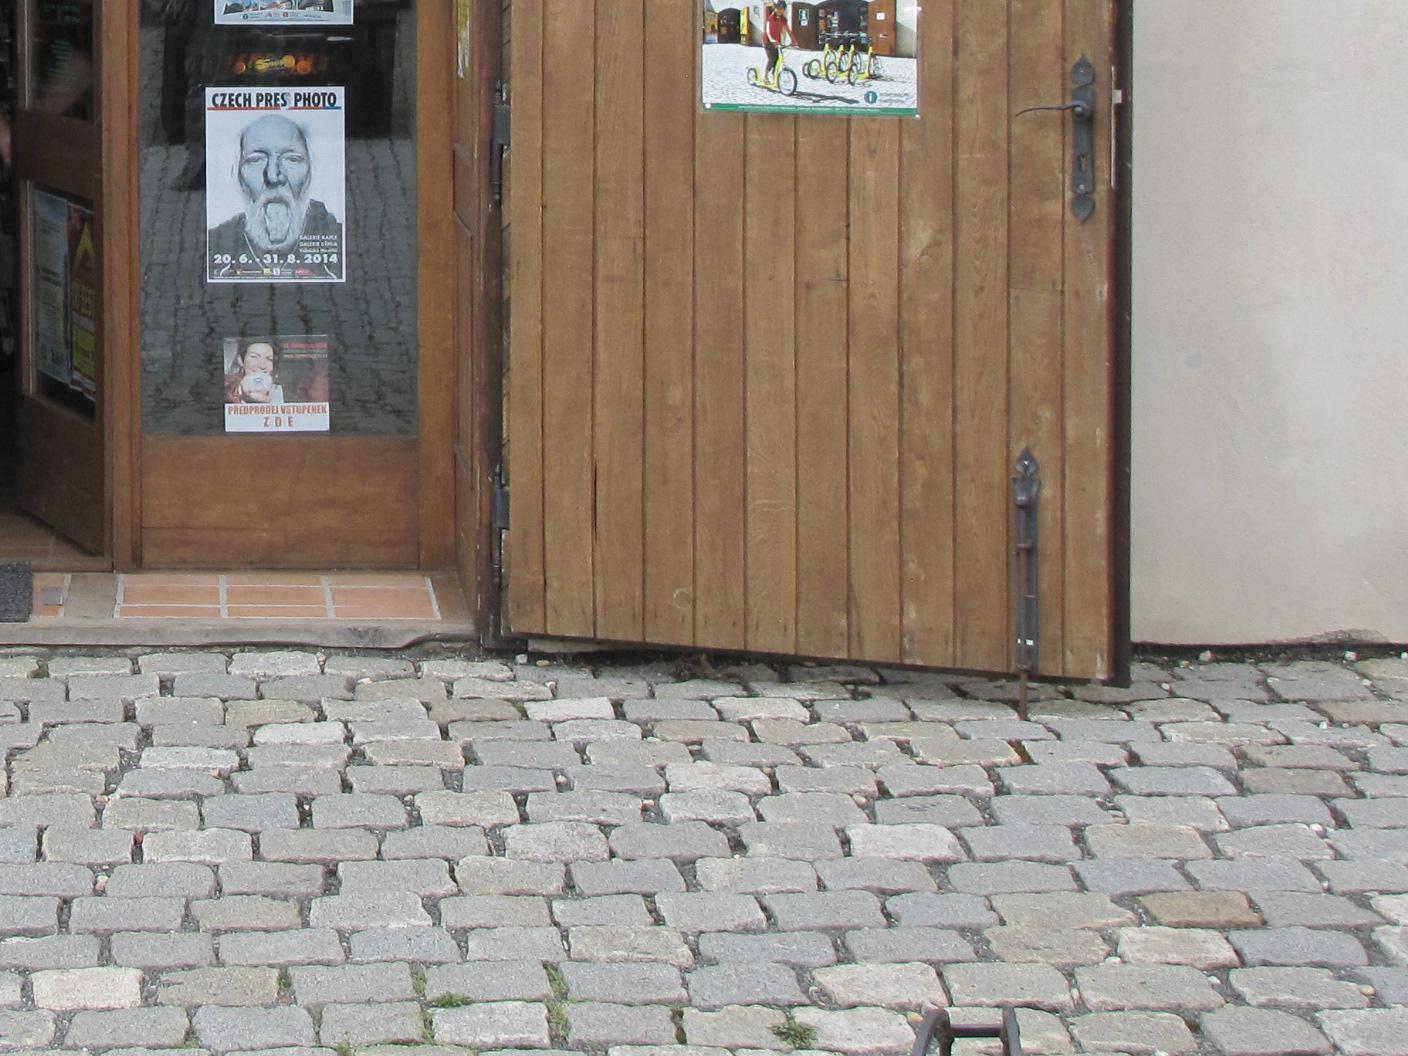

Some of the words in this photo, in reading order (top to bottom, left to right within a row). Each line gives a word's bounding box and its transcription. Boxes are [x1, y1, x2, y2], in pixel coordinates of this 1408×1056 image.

[211, 92, 252, 108] CZECH
[294, 92, 337, 108] PHOTO
[213, 253, 236, 264] 20.
[238, 253, 252, 264] 6.
[263, 253, 283, 264] 31.
[287, 253, 300, 264] 8.
[303, 253, 338, 264] 2014
[227, 404, 279, 415] PŘEDPRODEJ
[280, 404, 327, 415] VSTUPENEK
